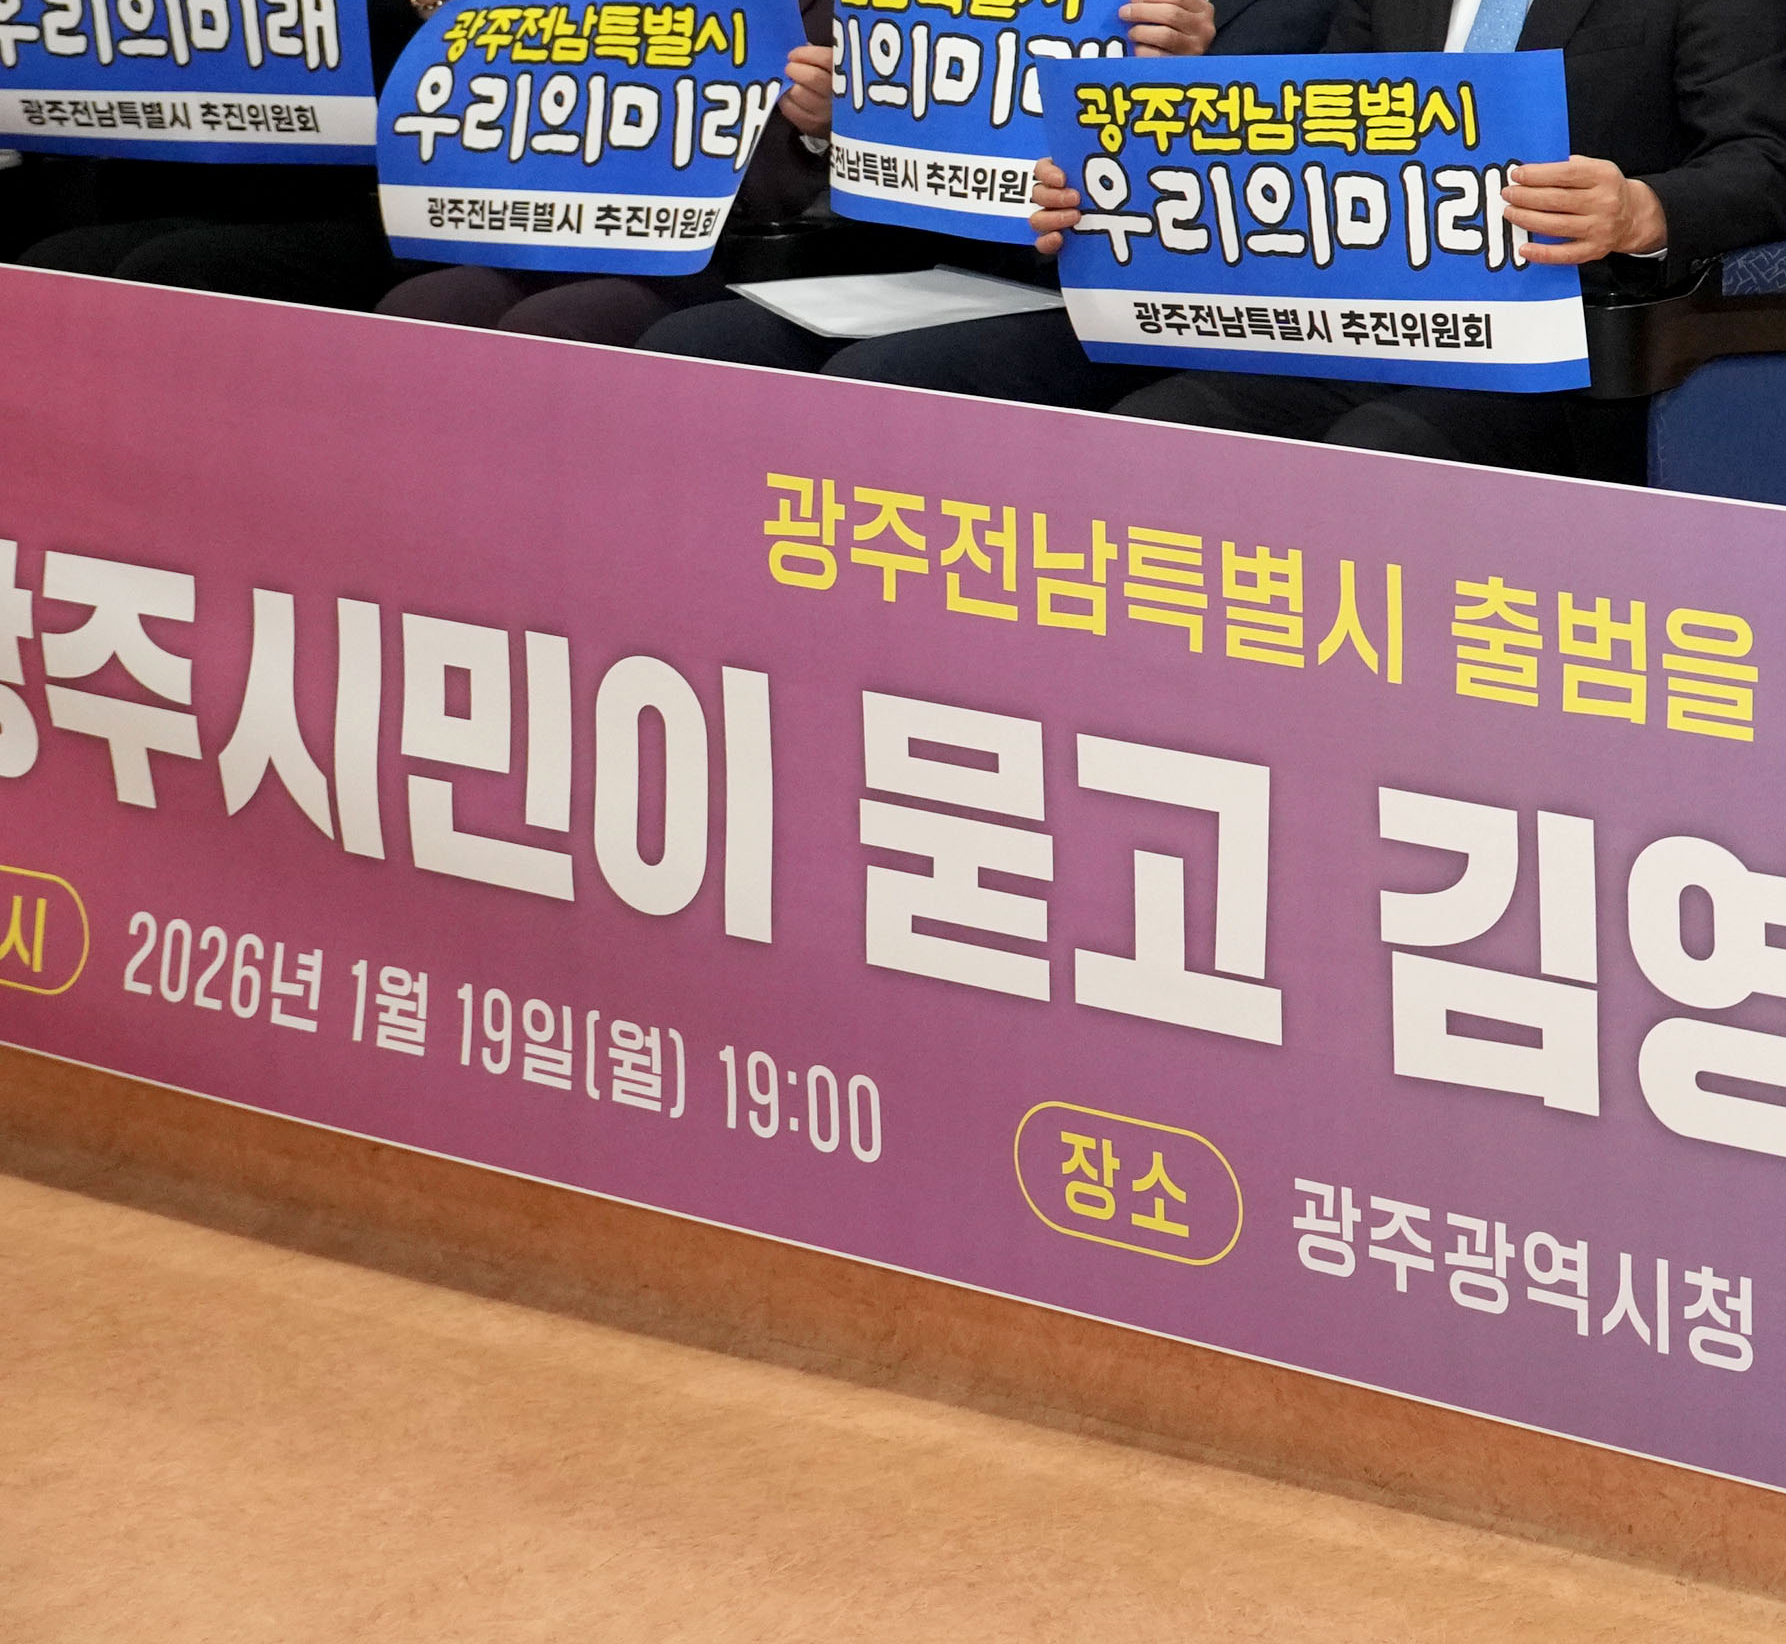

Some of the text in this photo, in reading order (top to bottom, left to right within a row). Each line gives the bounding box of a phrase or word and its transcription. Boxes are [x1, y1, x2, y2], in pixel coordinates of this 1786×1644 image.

[442, 3, 747, 67] 광주전남특별시
[21, 98, 321, 135] 광주전남특별시 추진위원회
[394, 65, 781, 169] 우리의미래
[1077, 80, 1478, 156] 광주전남특별시
[427, 197, 719, 239] 광주전남특별시 추진위원회
[926, 160, 1036, 205] 추진위원
[1075, 157, 1532, 269] 우리의미래
[1133, 299, 1494, 351] 광주전남특별시 추진위원회
[762, 469, 1407, 685] 광주전남특별시
[1450, 573, 1762, 744] 출범을
[857, 689, 1284, 1046] 묻고
[122, 909, 323, 1038] 2026년
[349, 956, 431, 1056] 1월
[456, 983, 691, 1119] 19일(월)
[717, 1044, 884, 1165] 19:00
[1060, 1135, 1194, 1242] 장소
[1290, 1177, 1757, 1373] 광주광역시청
